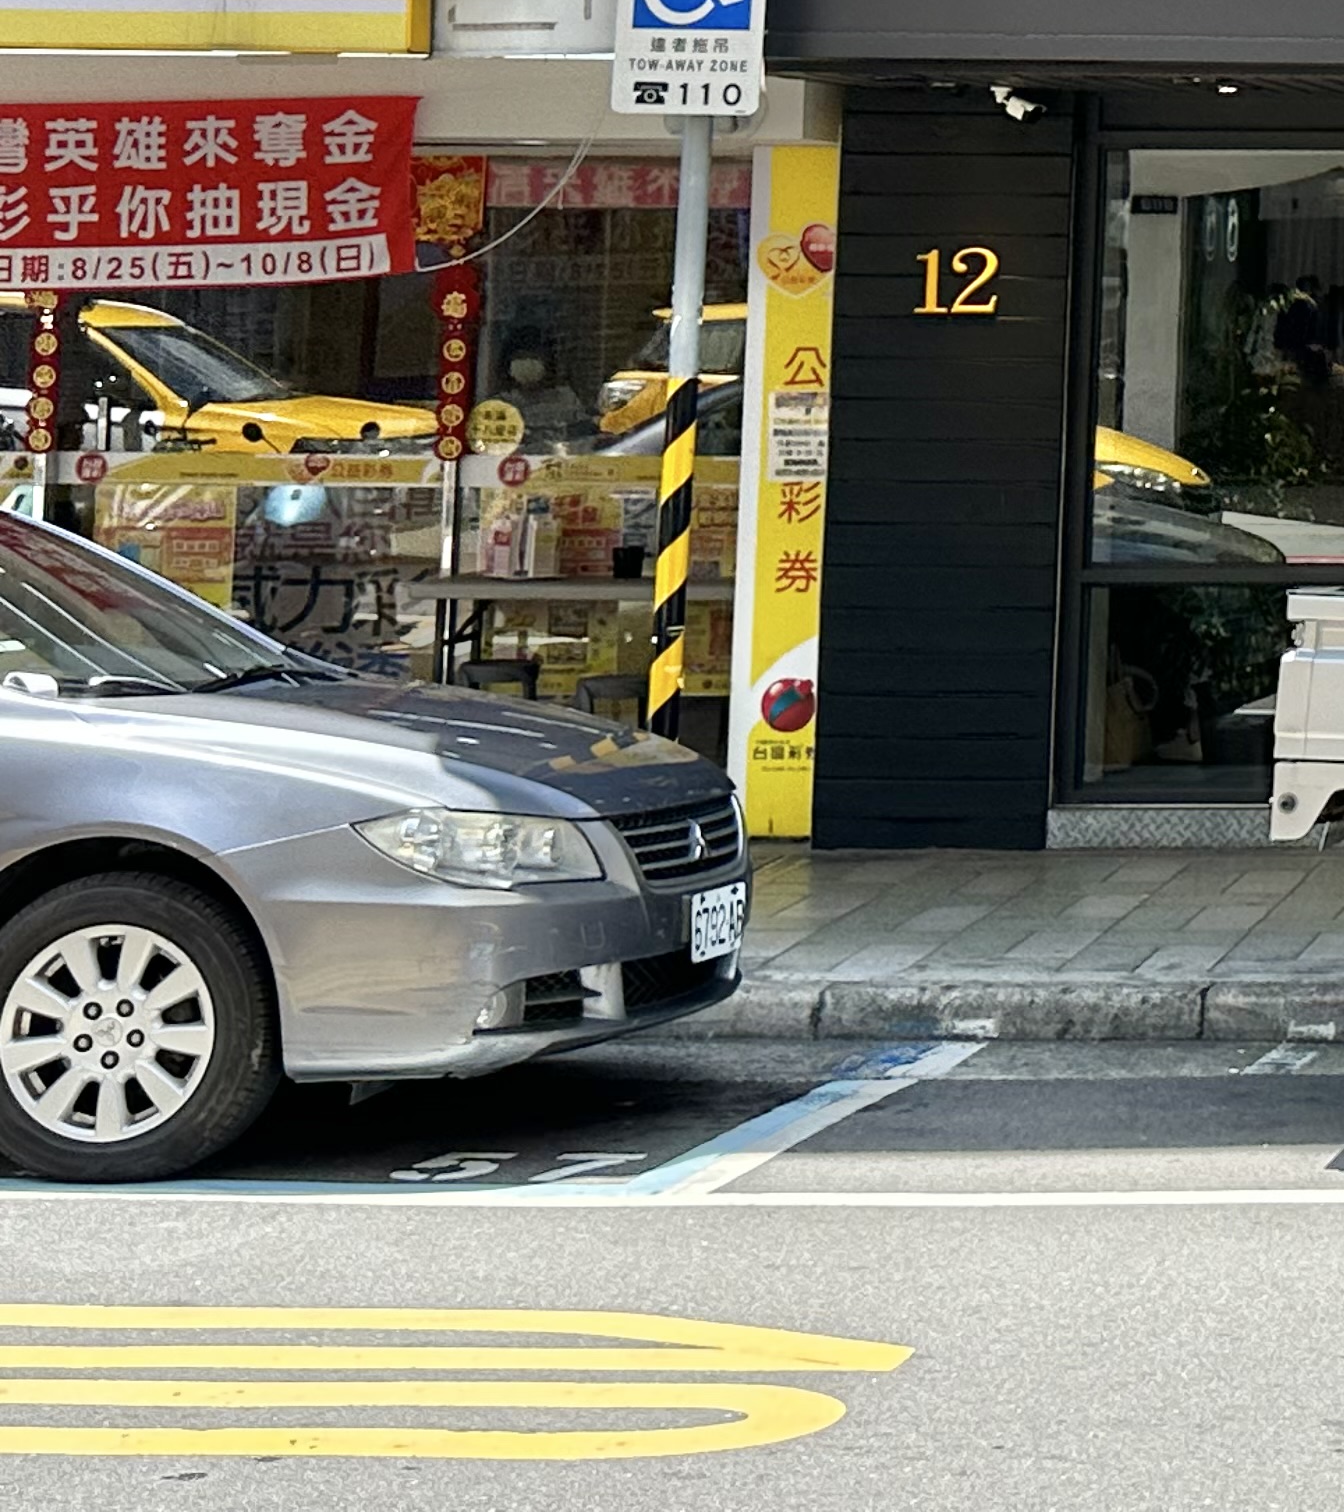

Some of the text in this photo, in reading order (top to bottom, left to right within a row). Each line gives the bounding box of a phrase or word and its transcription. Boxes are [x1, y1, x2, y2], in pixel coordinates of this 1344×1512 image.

[629, 57, 748, 74] TOW-AWAY ZONE
[680, 82, 742, 107] 110
[912, 246, 999, 314] 12
[774, 346, 828, 594] 公彩券
